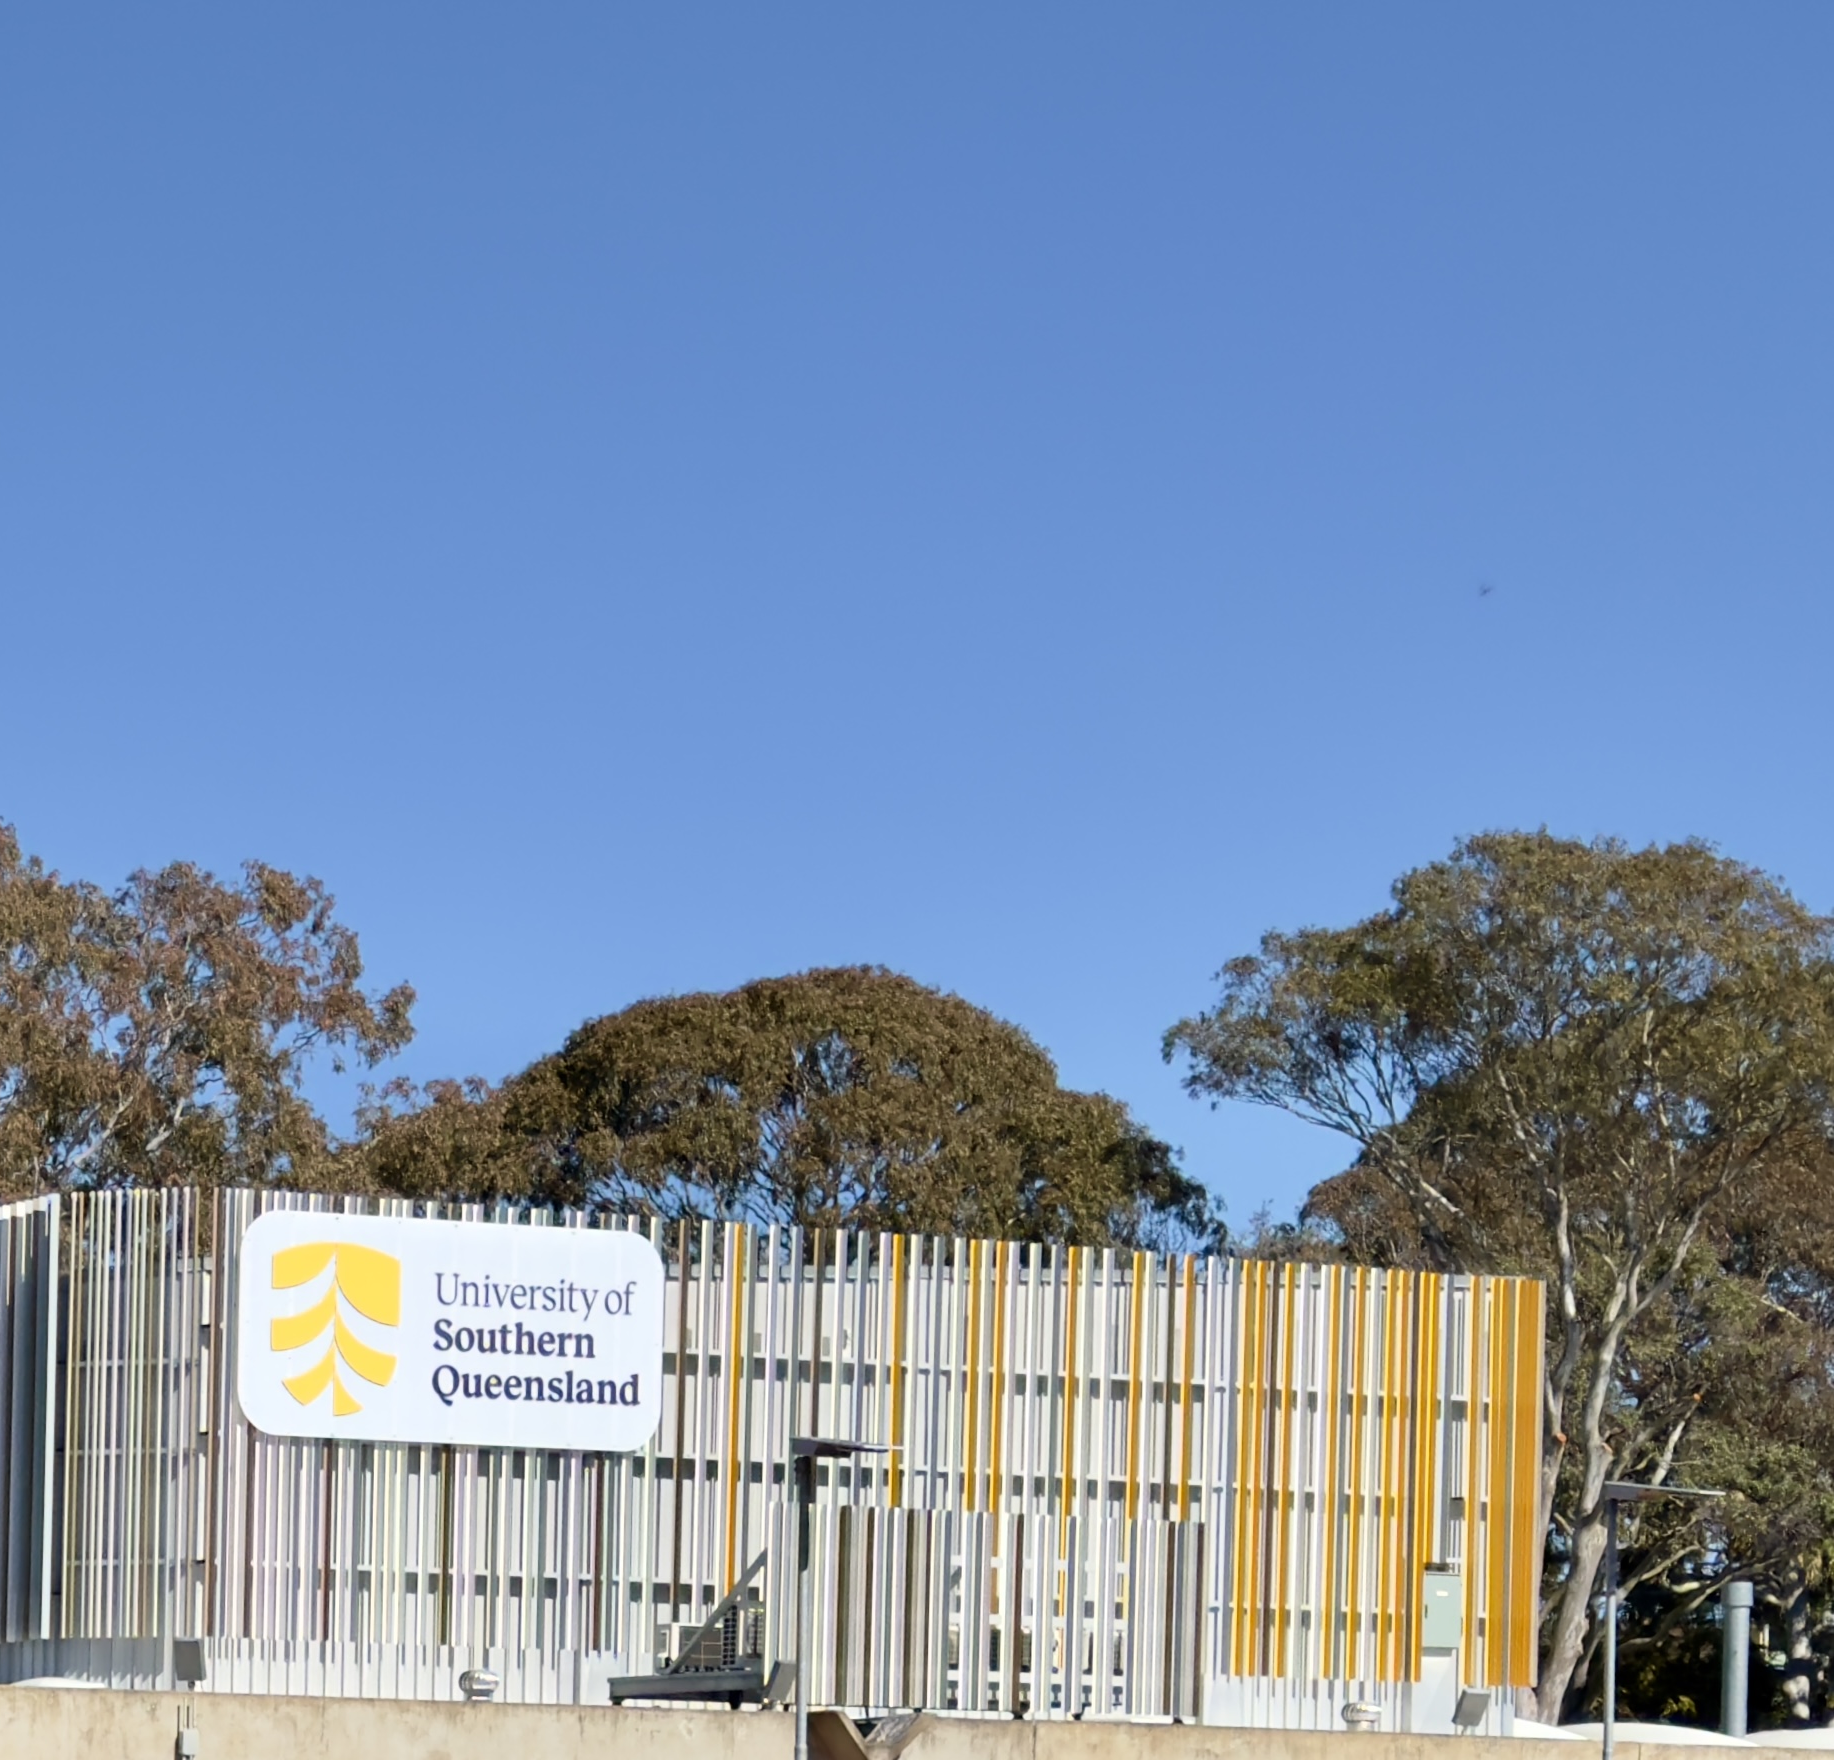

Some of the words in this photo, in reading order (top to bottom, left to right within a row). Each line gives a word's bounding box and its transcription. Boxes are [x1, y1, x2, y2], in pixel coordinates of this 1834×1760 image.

[435, 1272, 599, 1321] University
[604, 1281, 637, 1316] of
[433, 1318, 596, 1358] Southern
[432, 1364, 641, 1406] Queensland
